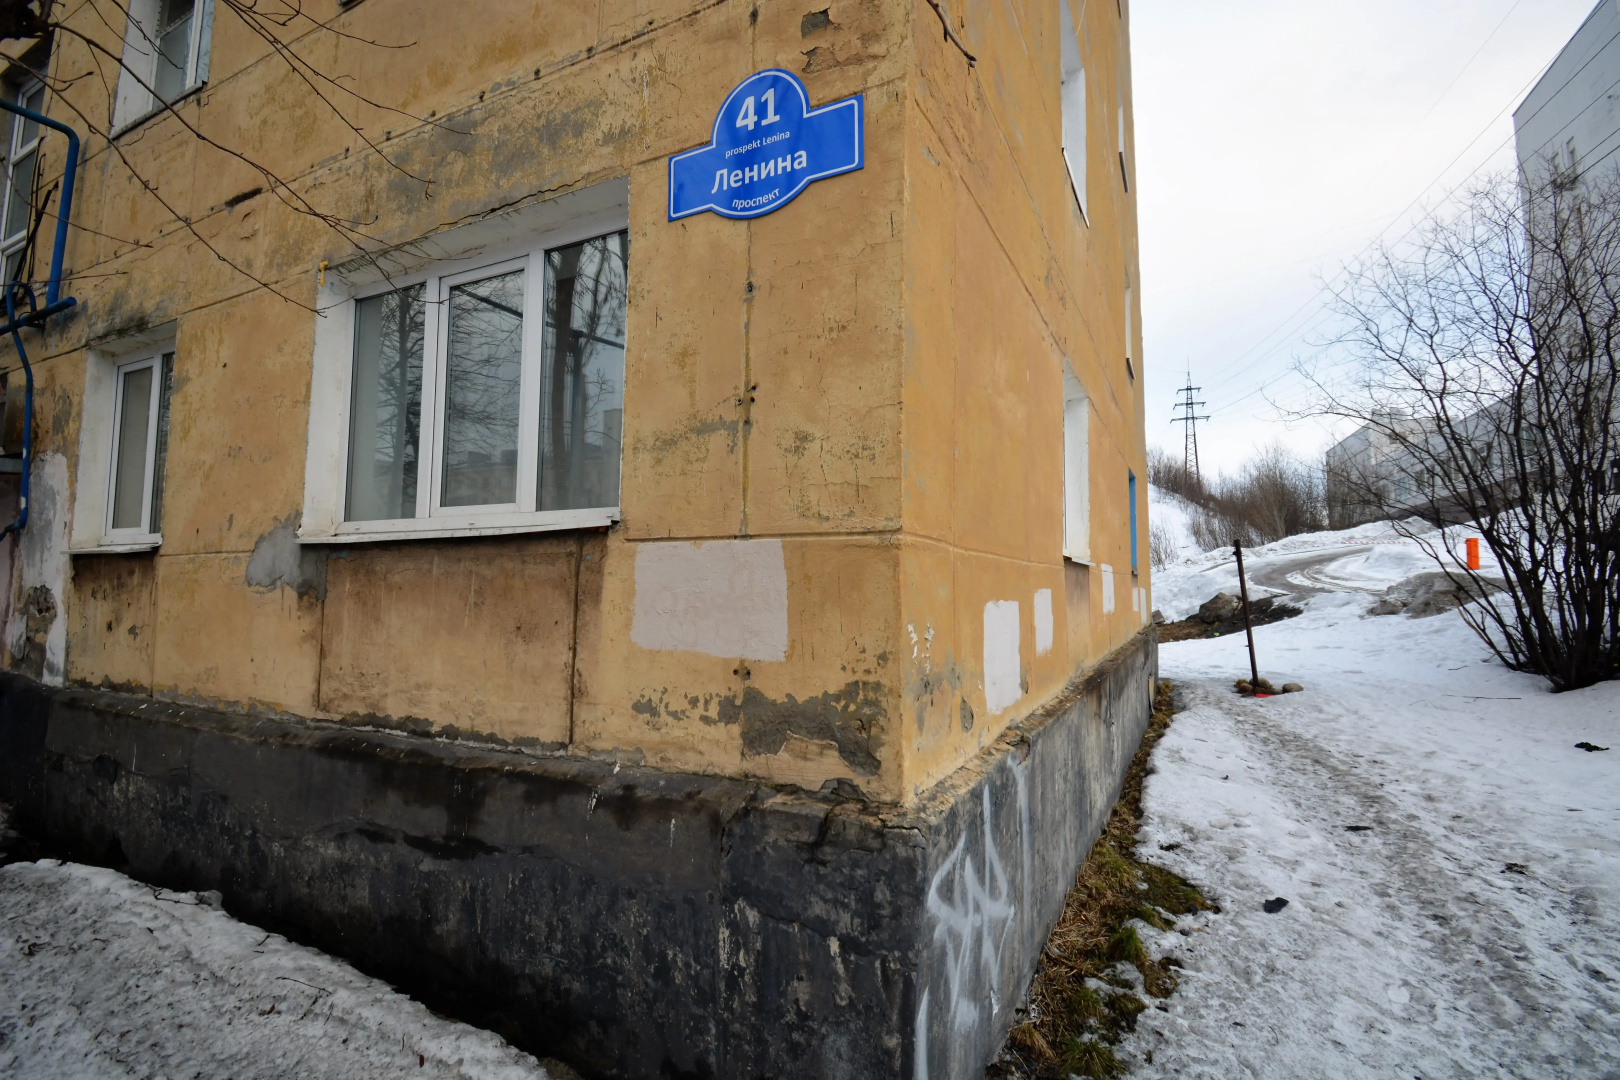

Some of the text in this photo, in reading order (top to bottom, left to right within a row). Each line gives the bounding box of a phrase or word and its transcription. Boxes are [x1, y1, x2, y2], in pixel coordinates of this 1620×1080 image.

[735, 87, 780, 131] 41
[725, 130, 790, 159] prospekt Lenina
[711, 150, 807, 195] Ленина
[732, 187, 780, 210] проспект
